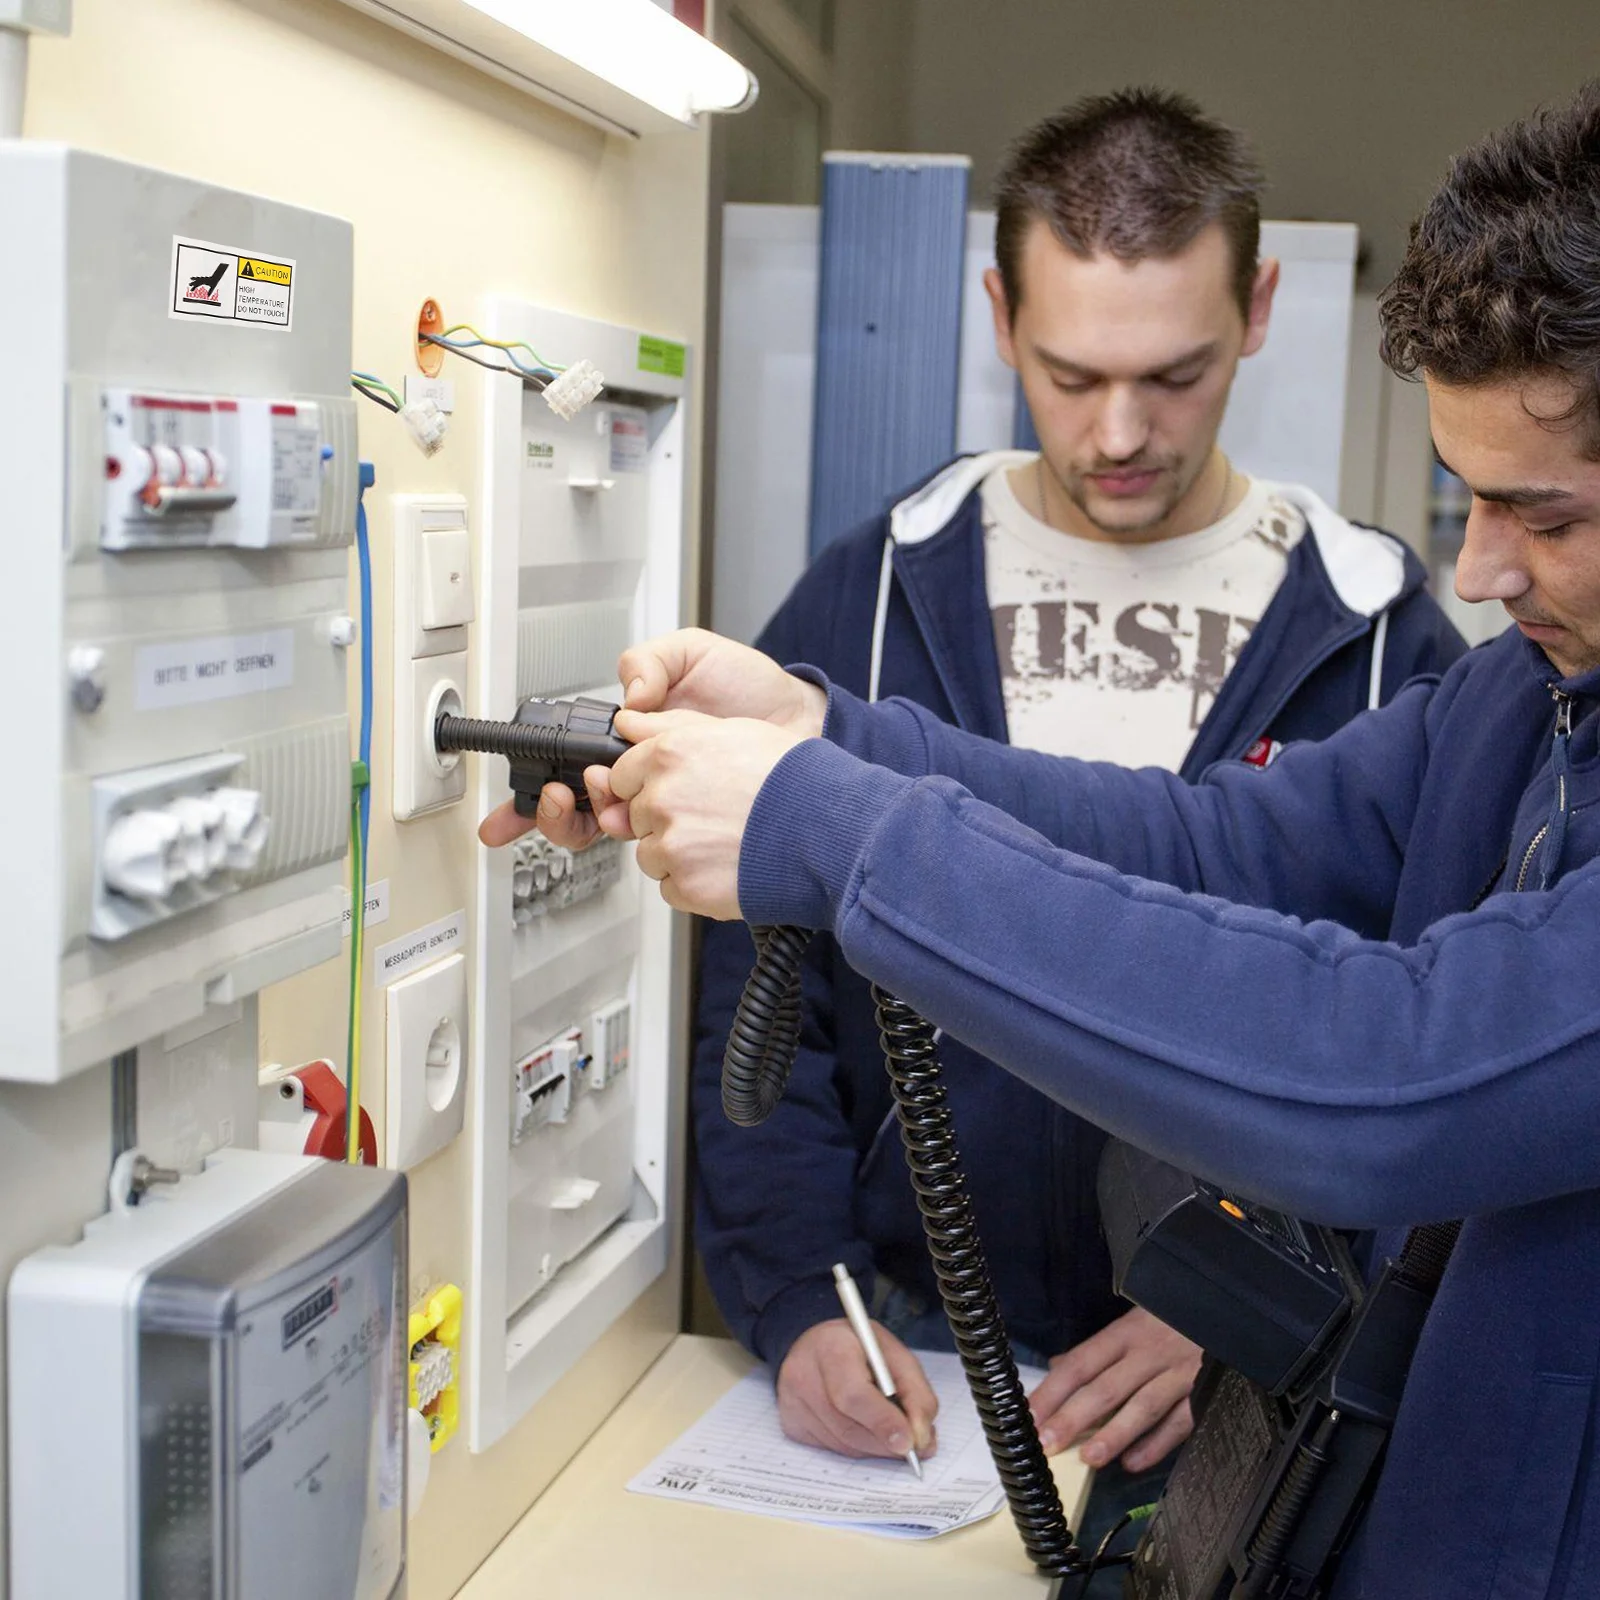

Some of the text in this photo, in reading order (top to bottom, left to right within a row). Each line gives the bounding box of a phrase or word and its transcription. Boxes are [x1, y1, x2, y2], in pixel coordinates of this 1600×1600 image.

[255, 266, 289, 280] CAUTION
[238, 285, 256, 294] HIGH
[238, 294, 285, 308] TEMPERATURE
[237, 305, 248, 313] DO
[249, 306, 263, 315] NOT
[153, 665, 188, 686] BITTE
[384, 926, 459, 969] MESSADAPTER BENUTZEN
